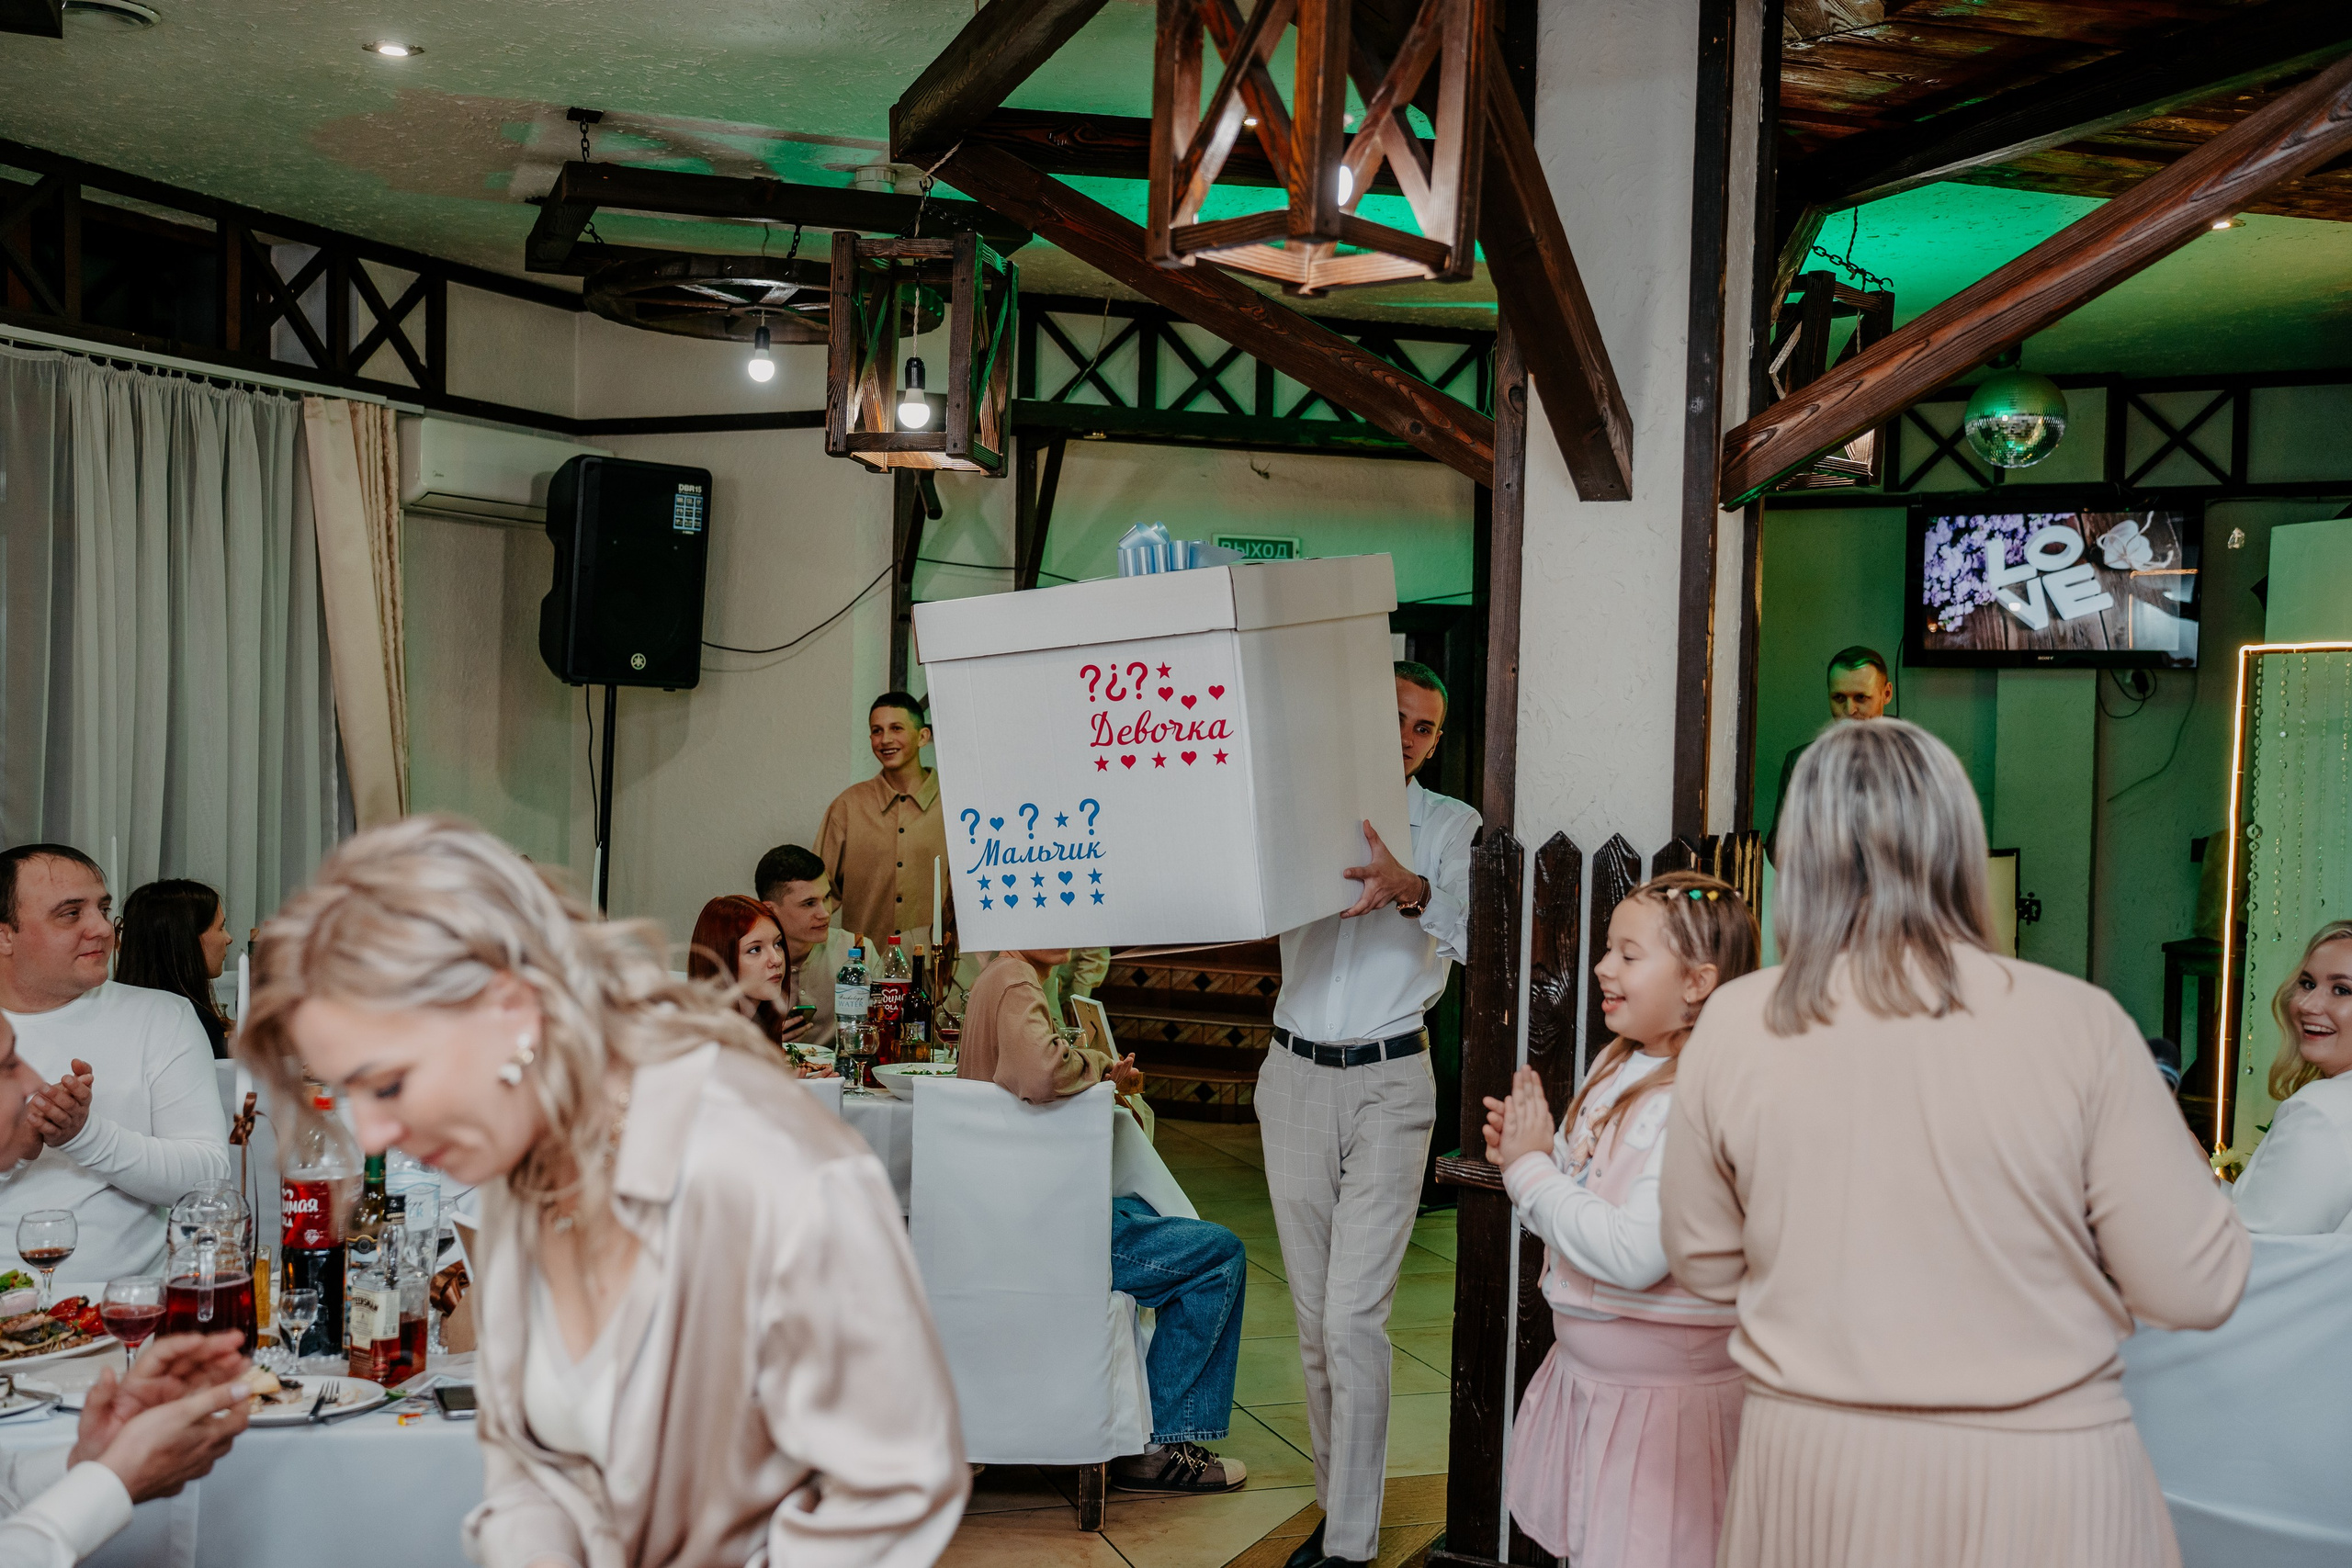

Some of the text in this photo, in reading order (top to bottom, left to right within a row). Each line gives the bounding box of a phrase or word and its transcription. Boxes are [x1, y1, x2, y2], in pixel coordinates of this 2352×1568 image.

[678, 483, 702, 493] DBR15
[1090, 710, 1234, 747] Девочка
[967, 838, 1106, 874] Мальчик
[352, 1296, 379, 1312] TEERSMAN
